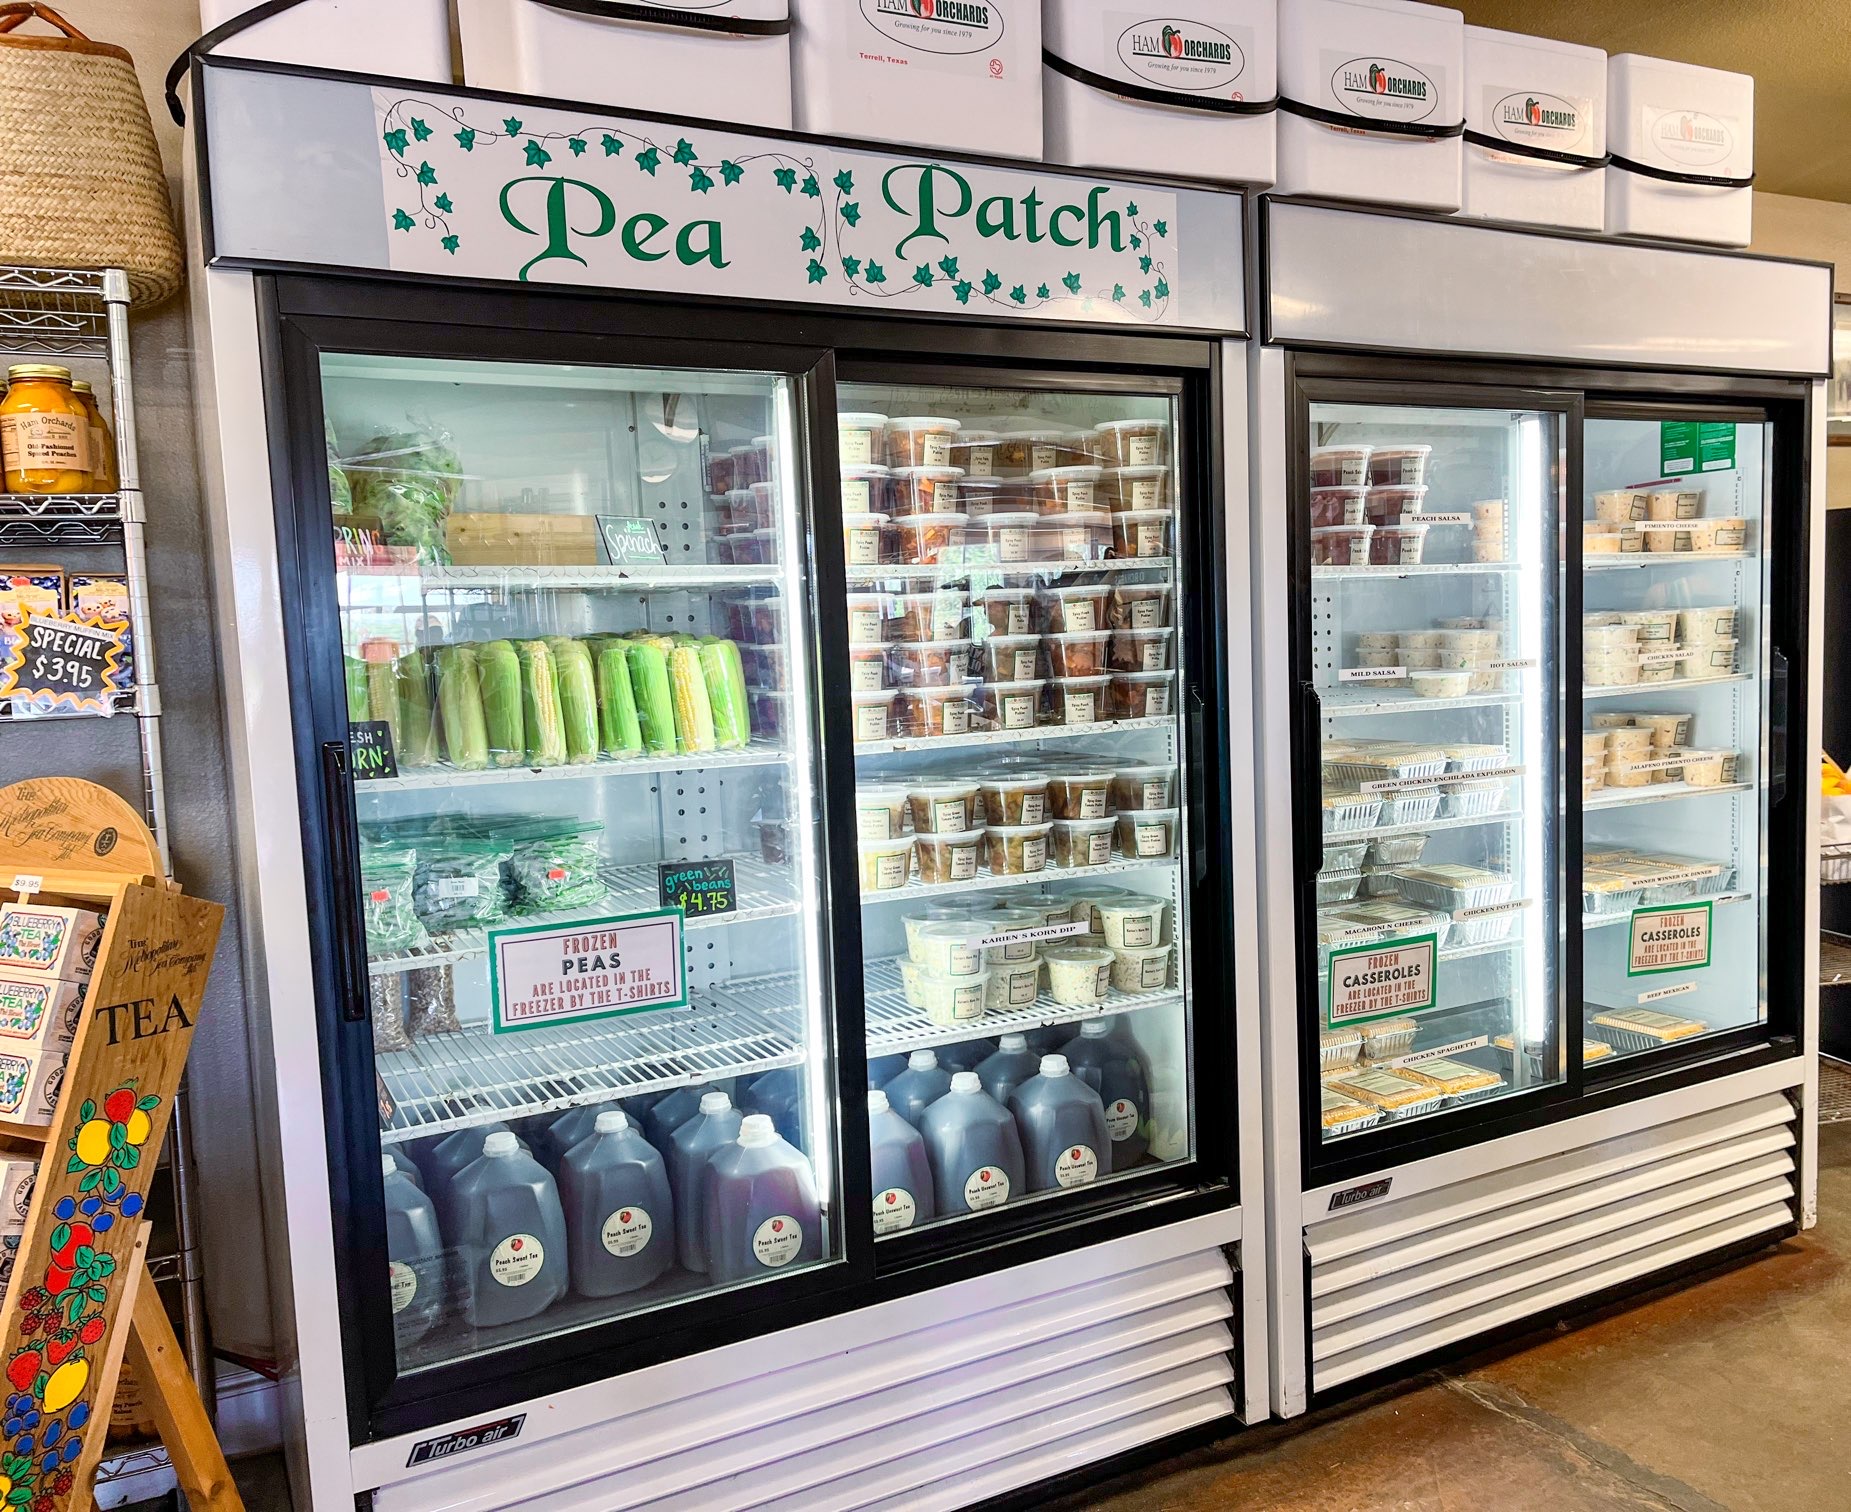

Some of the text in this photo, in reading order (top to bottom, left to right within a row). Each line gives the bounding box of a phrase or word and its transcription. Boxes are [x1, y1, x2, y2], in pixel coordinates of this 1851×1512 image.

[936, 0, 988, 25] ORCHARDS
[894, 20, 973, 39] Growing for you since 1979
[1132, 34, 1231, 61] HAM ORCHARDS
[859, 52, 908, 65] Terrell, Texas
[1147, 61, 1217, 75] Growing for you since 1979
[1344, 71, 1427, 97] HAM ORCHARDS
[1504, 105, 1576, 127] HAM ORCHARDS
[499, 161, 1129, 281] Pea Patch
[20, 416, 77, 432] Ham Orchards
[606, 524, 664, 563] Spinach
[338, 556, 365, 566] MIX
[31, 615, 72, 630] BLUEBERRY
[73, 624, 100, 637] MUFFIN
[31, 626, 103, 660] SPECIAL
[32, 654, 93, 688] $3.95
[1507, 660, 1529, 668] SALSA
[1350, 669, 1397, 678] MILD SALSA
[352, 745, 383, 769] RN
[1630, 762, 1661, 771] JALAPENO
[1371, 768, 1517, 790] GREEN CHICKEN ENCHILADA EXPLOSION
[14, 879, 40, 889] $9.95
[665, 870, 703, 894] green
[693, 879, 732, 891] beans
[1632, 878, 1656, 886] WINNER
[1657, 874, 1680, 882] WINNER
[1690, 869, 1712, 877] DINNER
[680, 891, 728, 912] $4.75
[1463, 907, 1495, 917] CHICKEN
[1495, 903, 1510, 911] POT
[12, 916, 59, 930] BLUEBERRY
[1344, 924, 1386, 936] MACARONI
[1393, 919, 1424, 928] CHEESE
[1660, 915, 1685, 928] FROZEN
[20, 928, 42, 940] TEA
[1030, 928, 1057, 938] KORN
[1059, 926, 1076, 934] DIP
[1641, 926, 1701, 943] CASSEROLES
[563, 932, 618, 956] FROZEN
[1644, 940, 1697, 954] ARE LOCATED IN THE
[562, 952, 621, 976] PEAS
[1368, 953, 1399, 970] FROZEN
[1634, 949, 1704, 966] FREEZER BY THE T-SHIRTS
[532, 968, 651, 998] ARE LOCATED IN THE
[1343, 963, 1421, 988] CASSEROLES
[1347, 980, 1416, 1001] ARE LOCATED IN THE
[1663, 985, 1690, 995] MEXICAN
[2, 996, 23, 1009] TEA
[512, 981, 671, 1017] FREEZER BY THE T-SHIRTS
[1336, 989, 1426, 1015] FREEZER BY THE T-SHIRTS
[95, 993, 194, 1047] TEA
[1402, 1040, 1477, 1064] CHICKEN SPAGHETTI
[981, 1184, 997, 1192] Unsweet
[1341, 1184, 1383, 1205] Turbo air
[607, 1223, 647, 1238] Peach Sweet Tea
[758, 1239, 773, 1247] Peach
[774, 1236, 788, 1244] Sweet
[496, 1252, 538, 1266] Peach Sweet Tea
[428, 1426, 509, 1458] Turbo air
